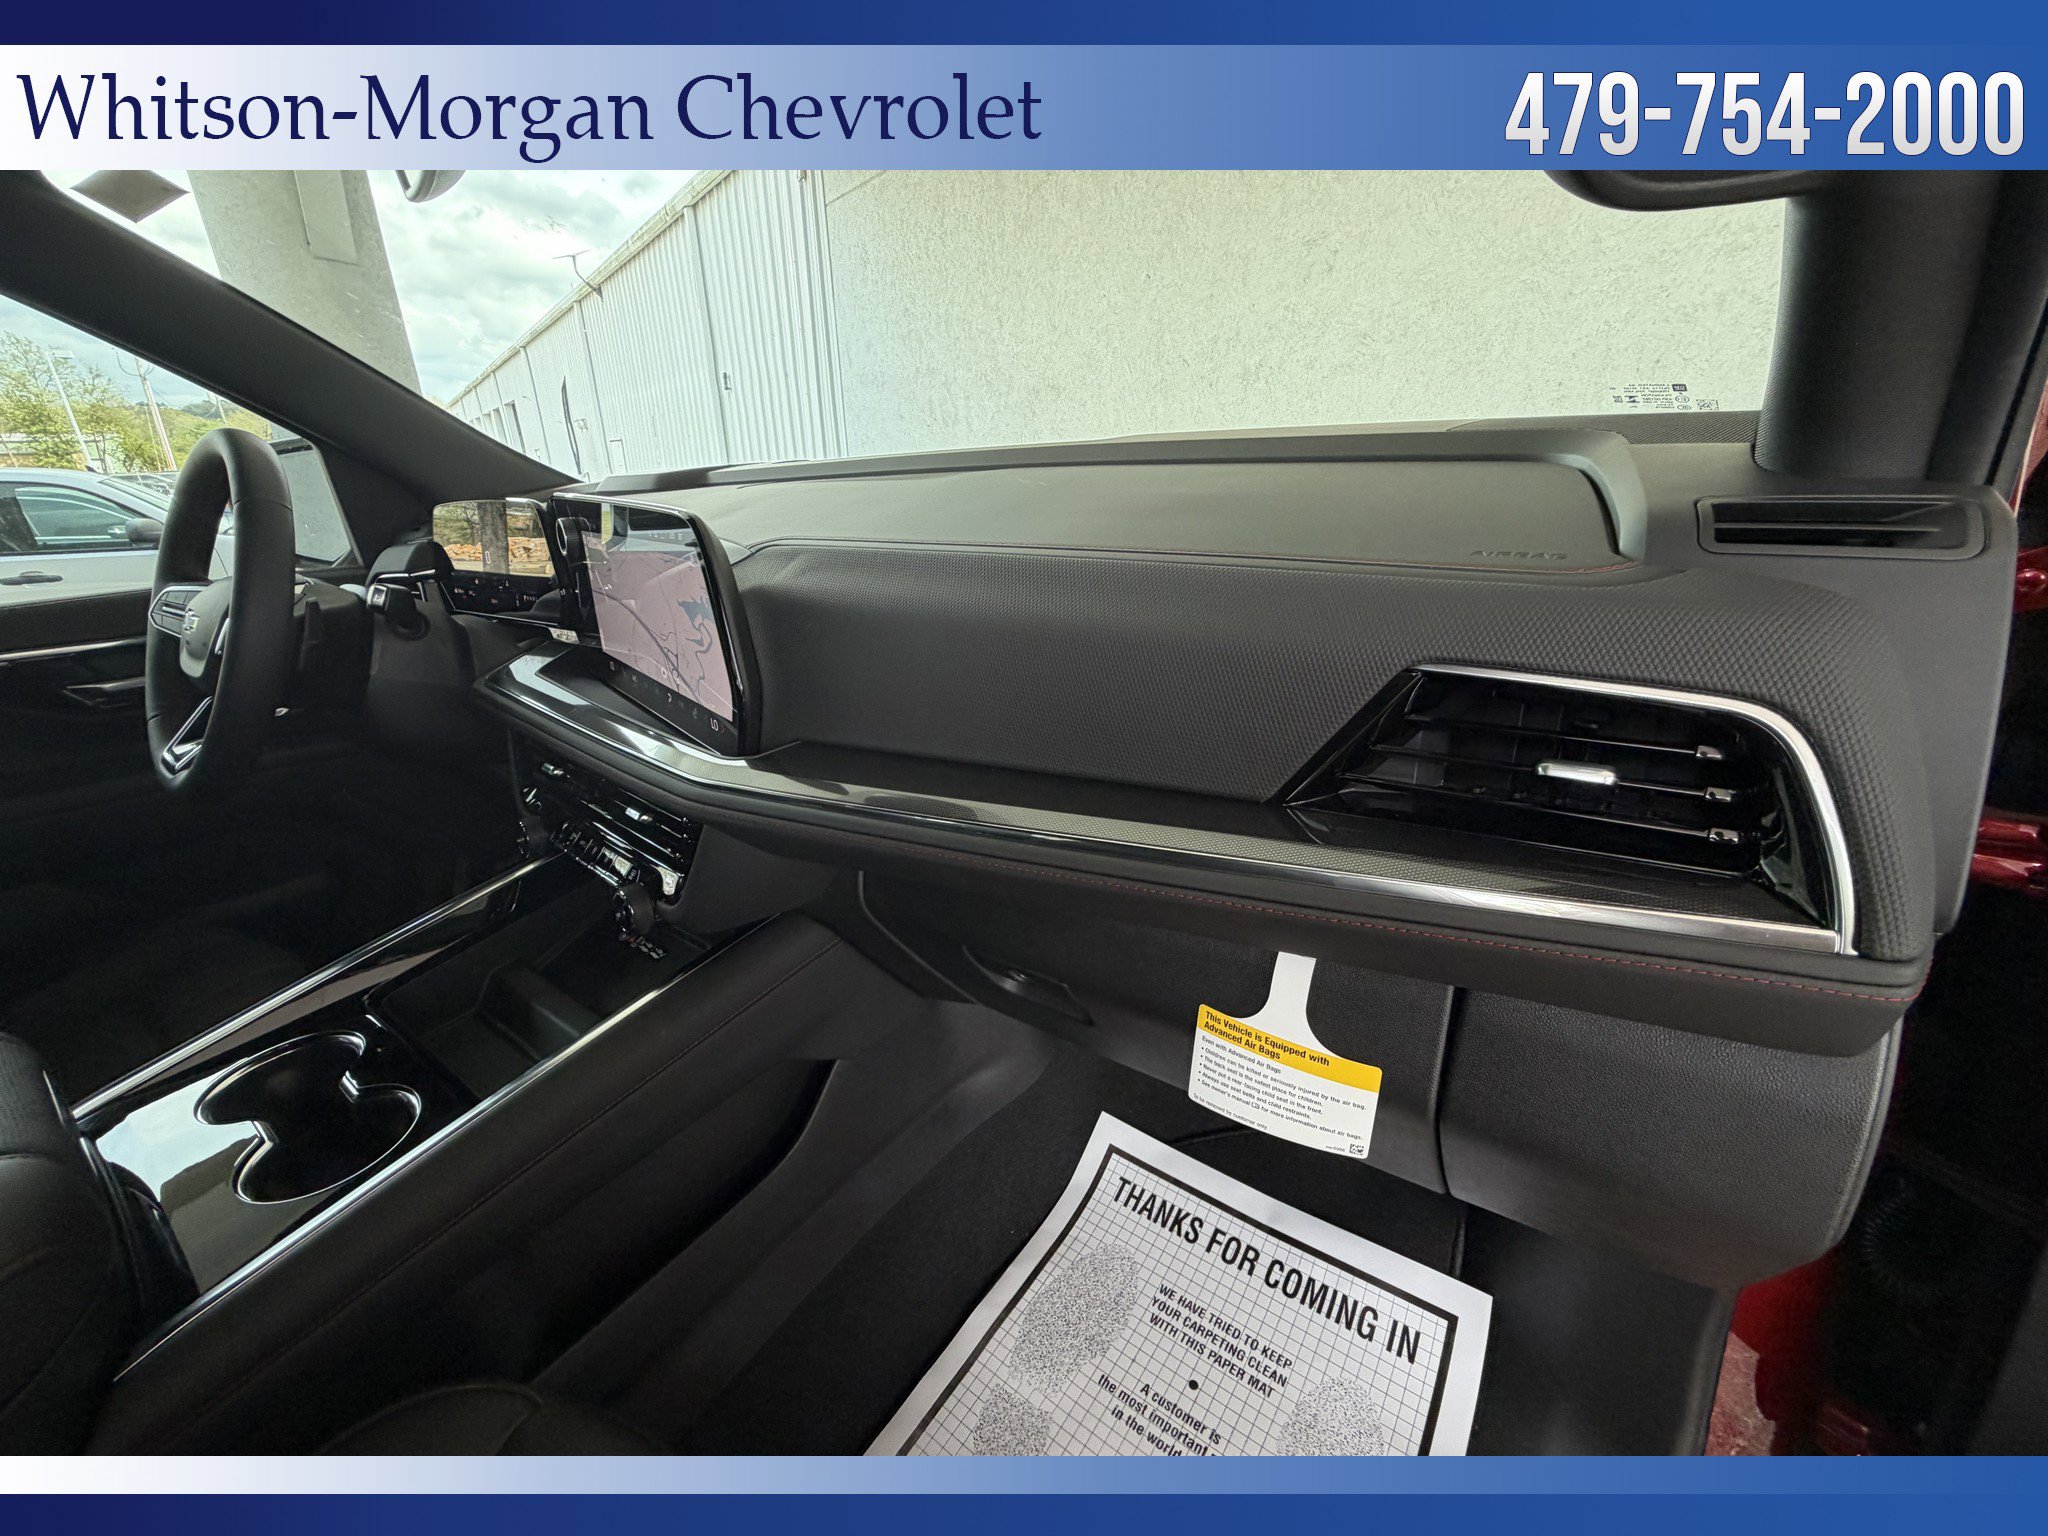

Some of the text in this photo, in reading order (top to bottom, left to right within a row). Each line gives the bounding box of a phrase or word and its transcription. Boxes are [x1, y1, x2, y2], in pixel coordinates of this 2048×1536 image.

[1202, 1035, 1282, 1074] Even with Advanced Air Bags
[1204, 1021, 1281, 1060] Advanced Air Bags
[1205, 1010, 1331, 1067] This Vehicle is Equipped with
[1202, 1072, 1220, 1084] Always
[1220, 1081, 1230, 1089] use
[1230, 1085, 1242, 1094] seat
[1242, 1089, 1256, 1100] belts
[1256, 1096, 1267, 1104] and
[1267, 1100, 1282, 1110] child
[1203, 1063, 1217, 1074] Never
[1217, 1070, 1227, 1080] put
[1261, 1090, 1276, 1099] child
[1276, 1095, 1288, 1104] seat
[1289, 1099, 1296, 1107] in
[1296, 1101, 1306, 1110] the
[1204, 1055, 1213, 1065] The
[1214, 1060, 1226, 1070] back
[1226, 1067, 1238, 1076] seat
[1244, 1073, 1254, 1082] the
[1254, 1078, 1271, 1089] safest
[1271, 1084, 1287, 1095] place
[1288, 1090, 1297, 1098] for
[1205, 1047, 1226, 1061] Children
[1227, 1058, 1237, 1067] can
[1238, 1062, 1245, 1070] be
[1246, 1064, 1262, 1077] killed
[1270, 1075, 1297, 1090] seriously
[1297, 1085, 1320, 1098] injured
[1320, 1092, 1329, 1101] by
[1330, 1095, 1341, 1104] the
[1201, 1080, 1211, 1088] See
[1231, 1094, 1251, 1106] manual
[1269, 1109, 1285, 1119] more
[1285, 1114, 1318, 1130] information
[1319, 1125, 1336, 1135] about
[1337, 1129, 1345, 1137] air
[1232, 1112, 1256, 1126] customer
[1112, 1175, 1423, 1366] THANKS FOR COMING IN
[1151, 1295, 1288, 1388] YOUR CARPETING CLEAN
[1159, 1283, 1293, 1369] WE HAVE TRIED TO KEEP
[1149, 1312, 1276, 1399] WITH THIS PAPER MAT
[1098, 1373, 1209, 1456] the most important
[1111, 1404, 1124, 1421] in
[1125, 1413, 1145, 1436] the
[1140, 1383, 1222, 1445] A customer is
